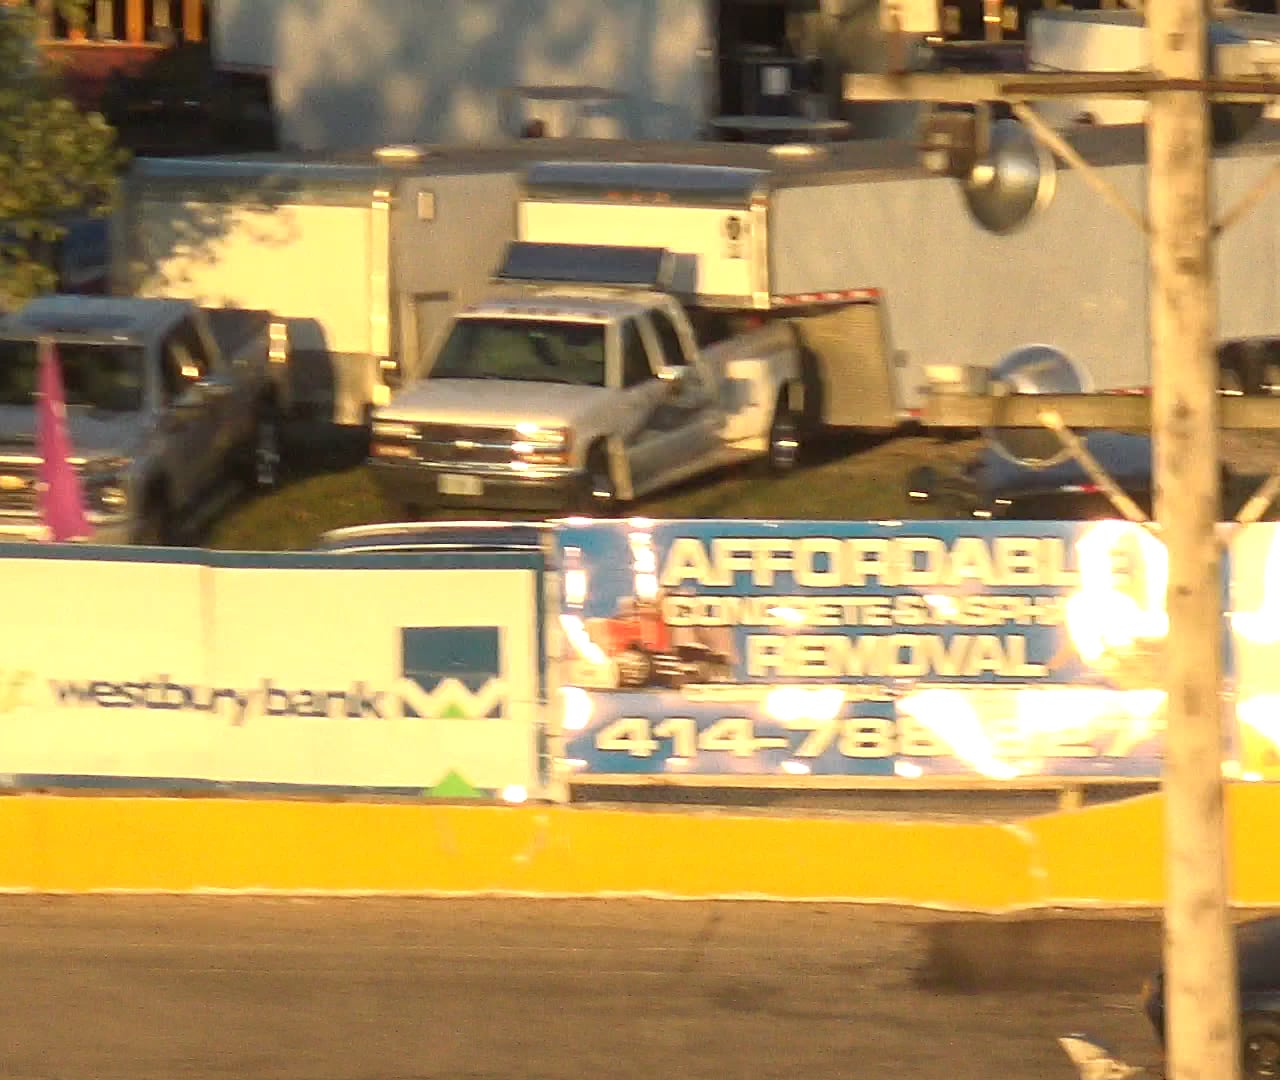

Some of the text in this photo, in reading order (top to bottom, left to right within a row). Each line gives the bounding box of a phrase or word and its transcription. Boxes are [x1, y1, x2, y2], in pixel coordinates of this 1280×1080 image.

[746, 633, 1051, 677] REMOVAL
[48, 673, 250, 727] westbury
[261, 678, 388, 719] bank
